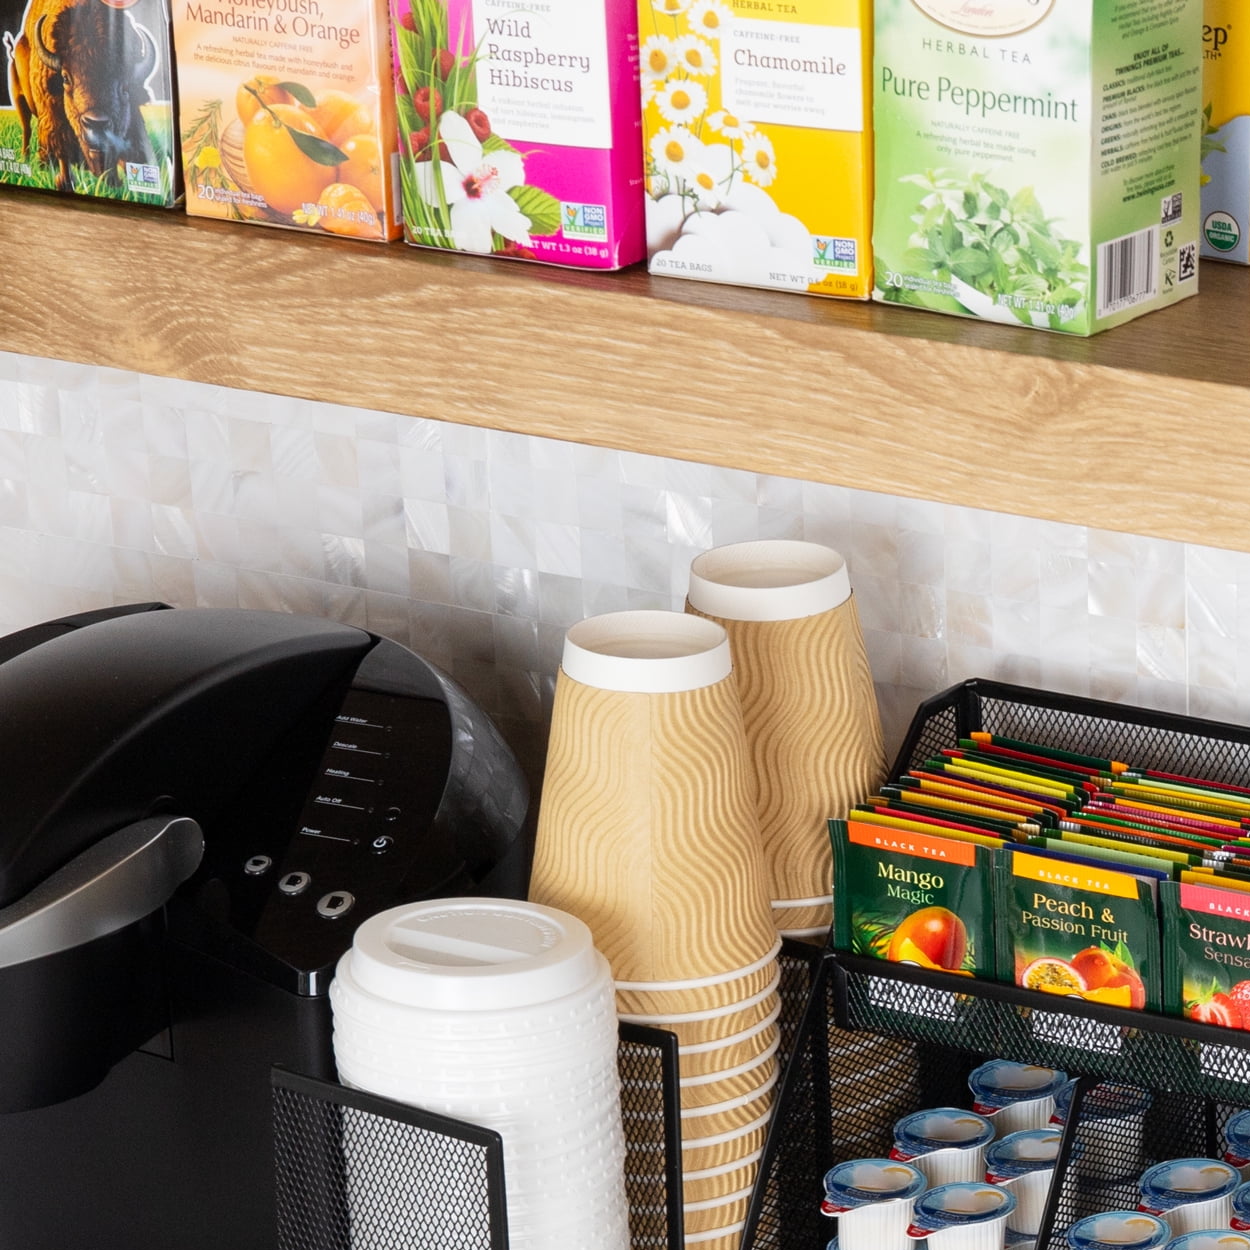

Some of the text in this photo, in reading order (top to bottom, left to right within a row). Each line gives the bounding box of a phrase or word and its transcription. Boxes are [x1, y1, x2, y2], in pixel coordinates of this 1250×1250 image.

[219, 0, 324, 21] oneybush,
[732, 0, 798, 15] HERBAL TEA
[186, 3, 361, 50] Mandarin & Orange
[486, 17, 532, 39] Wild
[487, 43, 590, 73] Raspberry
[922, 37, 1033, 65] HERBAL TEA
[733, 48, 847, 76] Chamomile
[489, 68, 574, 93] Hibiscus
[881, 66, 931, 101] Pure
[937, 76, 1079, 122] Peppermint
[197, 184, 215, 201] 20
[584, 206, 603, 215] NON
[584, 212, 603, 222] GMO
[565, 224, 605, 235] VERIFIED
[1211, 219, 1233, 233] USDA
[834, 239, 855, 249] NON
[1208, 231, 1236, 244] ORGANIC
[541, 241, 583, 255] WT 1.3 oz
[834, 246, 855, 256] GMO
[655, 258, 713, 273] 20 TEA BAGS
[813, 257, 856, 270] VERIFIED
[768, 271, 833, 288] NET WT oz
[884, 271, 903, 288] 20
[1013, 296, 1026, 309] WT
[315, 794, 331, 803] Auto
[301, 826, 322, 835] Power
[874, 836, 947, 858] BLACK TEA
[877, 861, 945, 890] Mango
[1038, 869, 1111, 891] BLACK TEA
[887, 883, 935, 905] Magic
[1032, 892, 1116, 925] Peach &
[1208, 902, 1250, 917] BLACK
[1021, 910, 1129, 944] Passion Fruit
